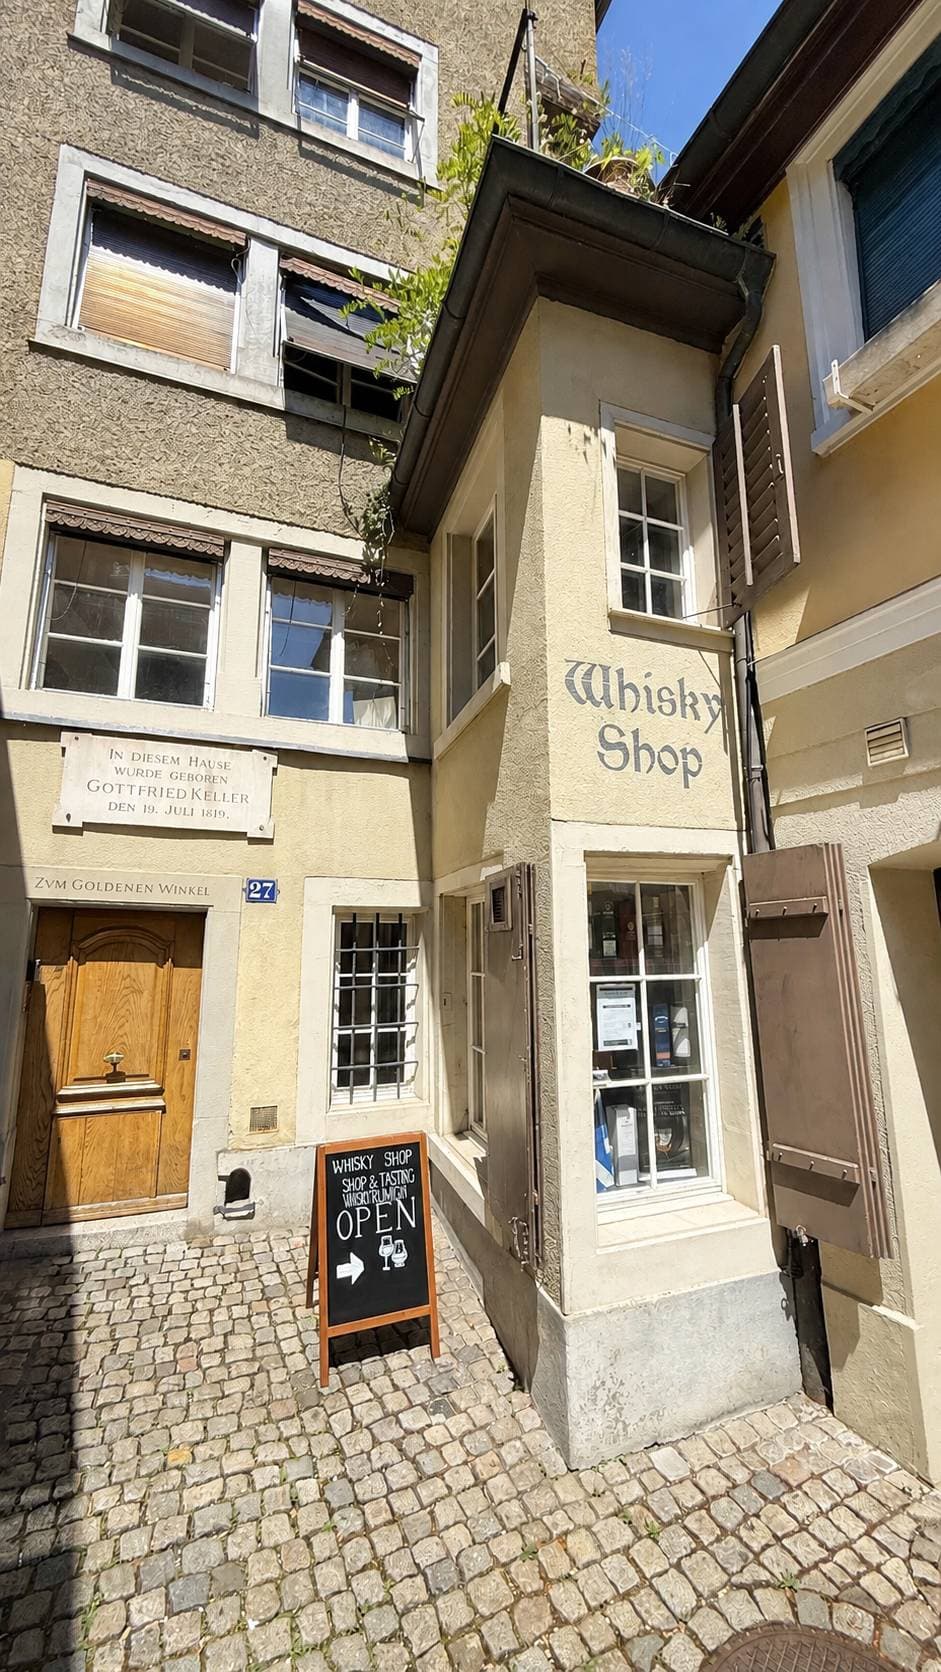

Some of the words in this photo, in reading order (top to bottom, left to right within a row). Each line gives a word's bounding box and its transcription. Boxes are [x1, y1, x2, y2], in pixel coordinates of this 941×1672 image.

[564, 658, 722, 734] Whisky
[109, 748, 123, 761] IN
[131, 752, 180, 766] DIESEM
[189, 756, 231, 771] HAUSE
[597, 724, 703, 789] Shop
[115, 766, 162, 779] WURDE
[170, 771, 228, 785] GEBOREN
[87, 779, 187, 801] GOTTFRIED
[192, 788, 249, 804] KELLER
[108, 800, 136, 813] DEN
[143, 804, 158, 815] 19.
[165, 805, 194, 817] JULI
[201, 808, 230, 820] 1819.
[71, 878, 153, 894] GOLDENEN
[159, 883, 210, 897] WINKEL
[249, 881, 274, 899] 27
[332, 1154, 374, 1174] WHISKY
[384, 1149, 413, 1167] SHOP
[342, 1175, 367, 1193] SHOP
[369, 1174, 379, 1189] &
[379, 1168, 415, 1187] TASTING
[336, 1196, 416, 1241] OPEN
